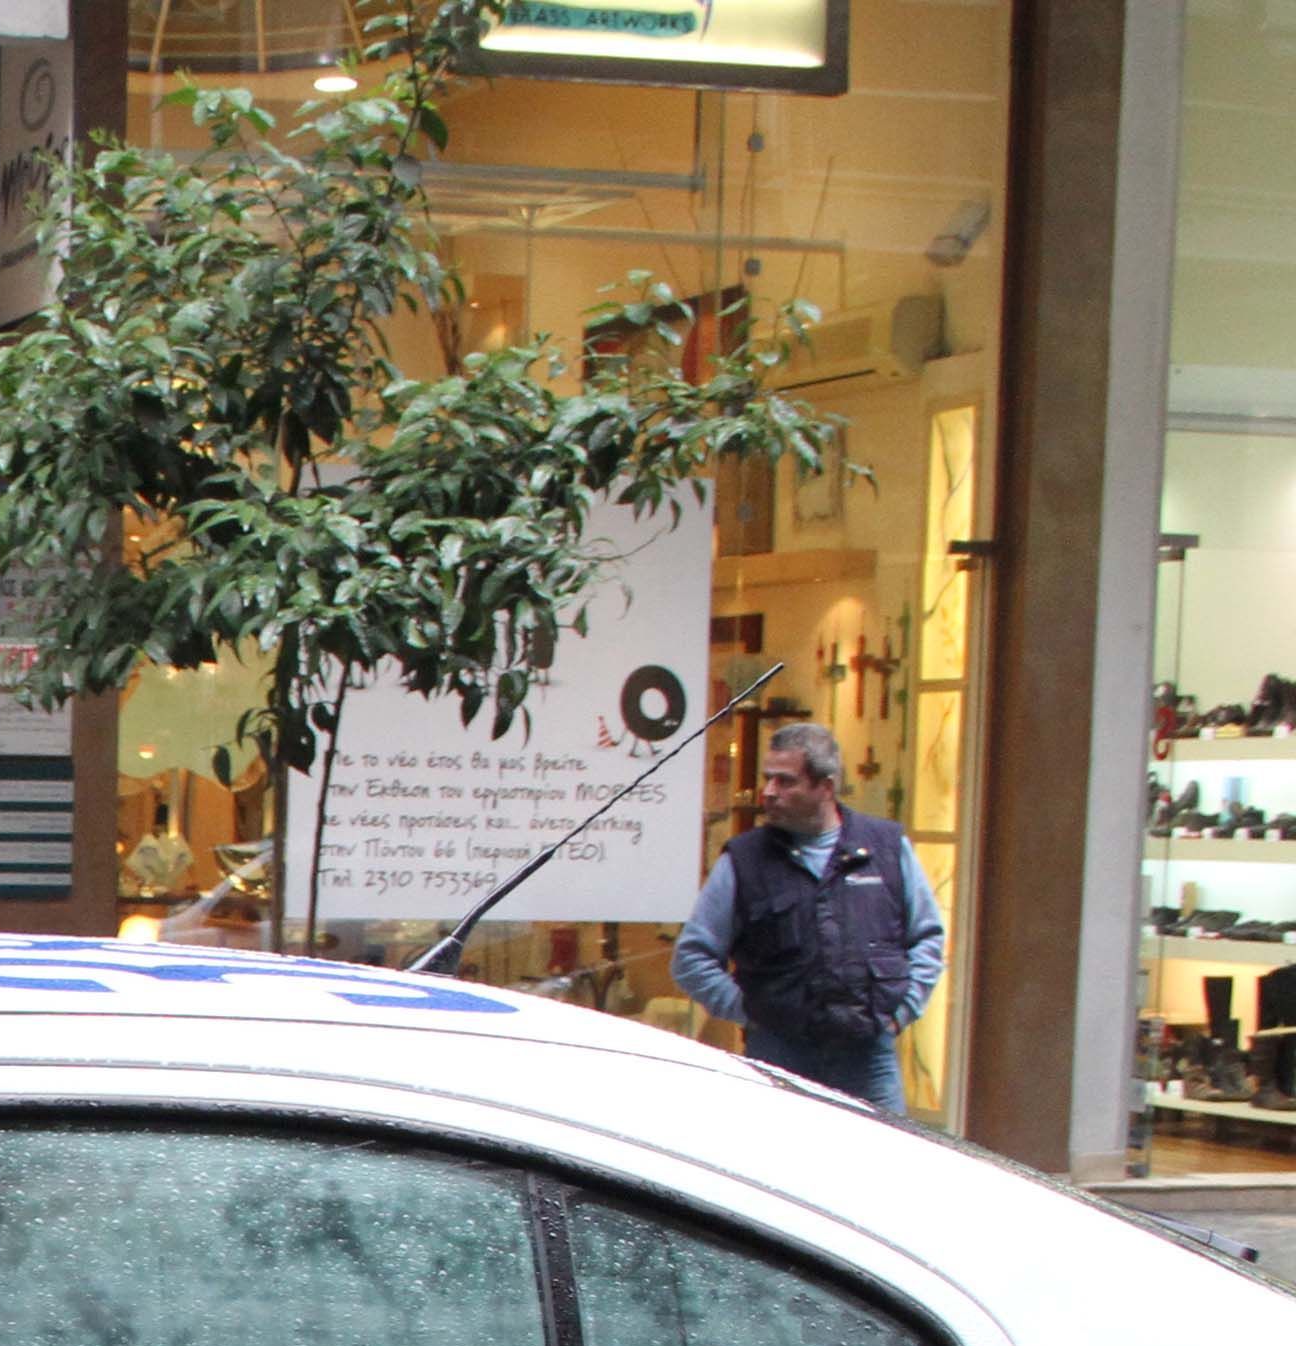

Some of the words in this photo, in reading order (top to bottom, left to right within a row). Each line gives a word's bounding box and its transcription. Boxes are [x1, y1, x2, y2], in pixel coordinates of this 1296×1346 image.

[361, 753, 379, 767] το
[433, 839, 456, 858] 66
[364, 869, 413, 896] 2310
[421, 870, 498, 896] 753369
